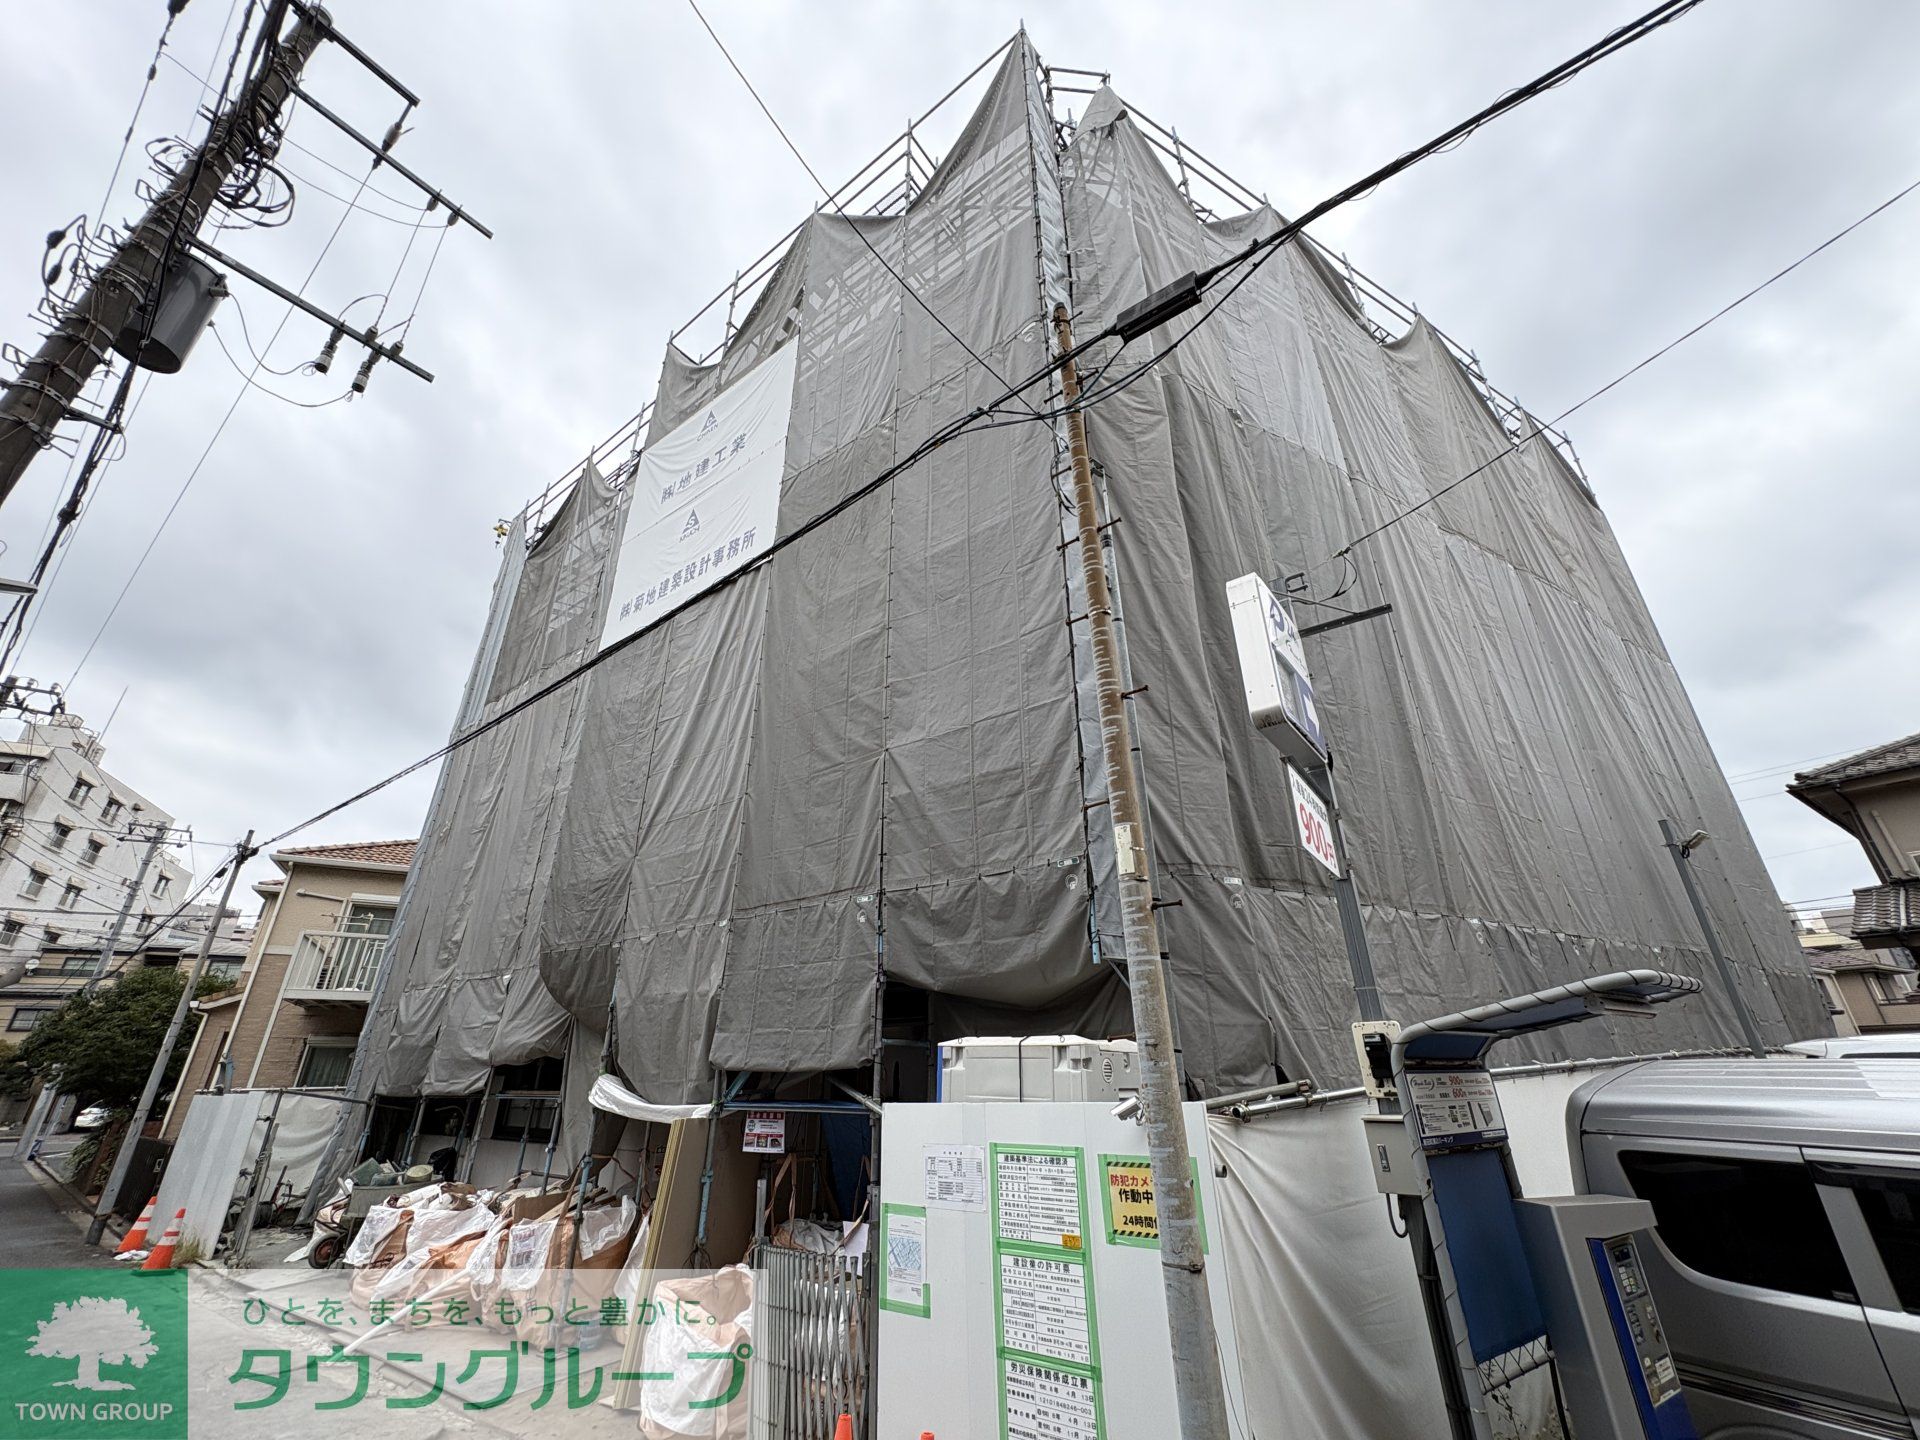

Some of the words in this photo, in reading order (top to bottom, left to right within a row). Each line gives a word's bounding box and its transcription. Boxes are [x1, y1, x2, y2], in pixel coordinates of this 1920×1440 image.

[1110, 1174, 1153, 1187] 防犯カメ
[1118, 1188, 1153, 1204] 作動中
[1013, 1257, 1070, 1273] 建設業の許可票
[1011, 1362, 1088, 1389] 労災保険関係成立票
